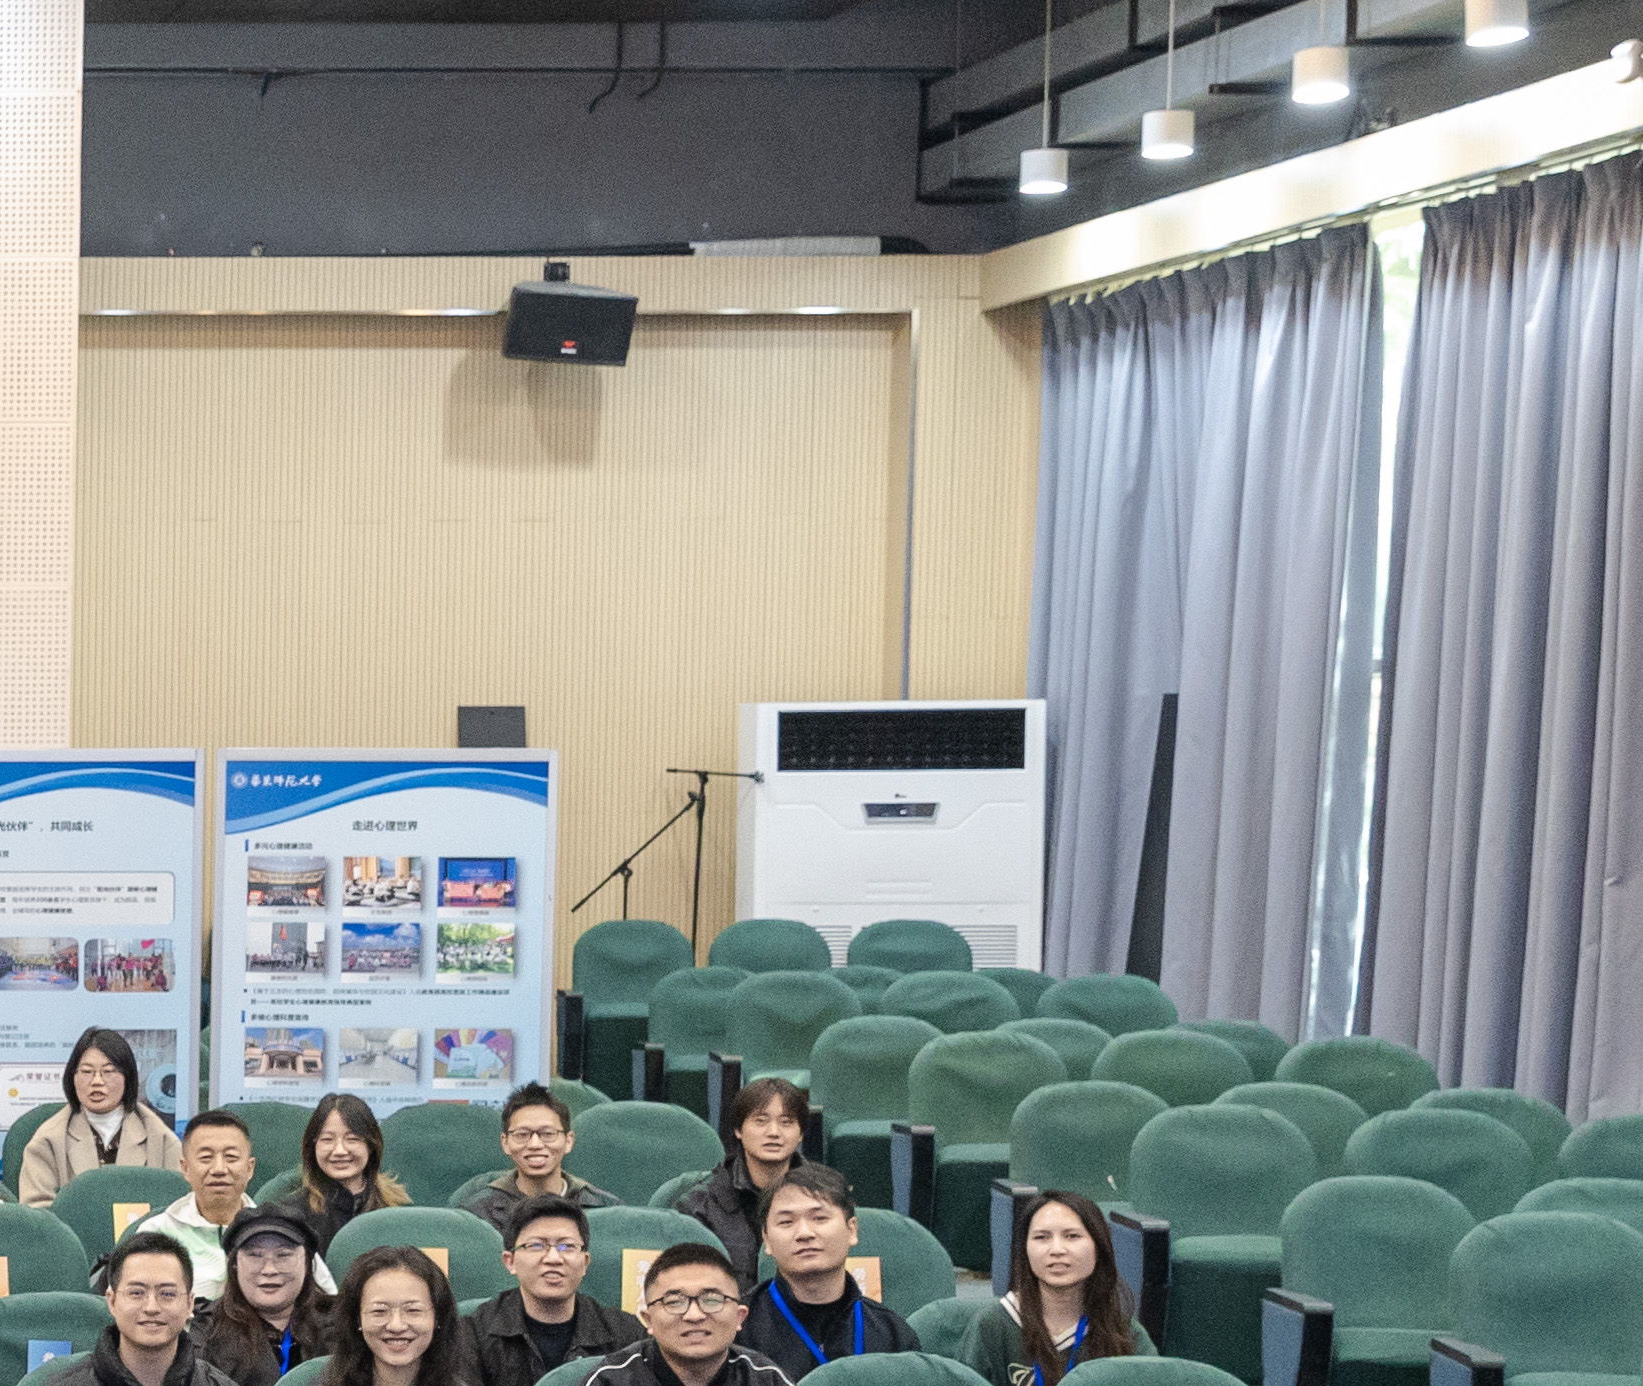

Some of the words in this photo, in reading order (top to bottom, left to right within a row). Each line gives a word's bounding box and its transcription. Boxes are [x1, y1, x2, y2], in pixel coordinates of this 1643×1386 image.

[352, 820, 418, 832] 走进心理世界
